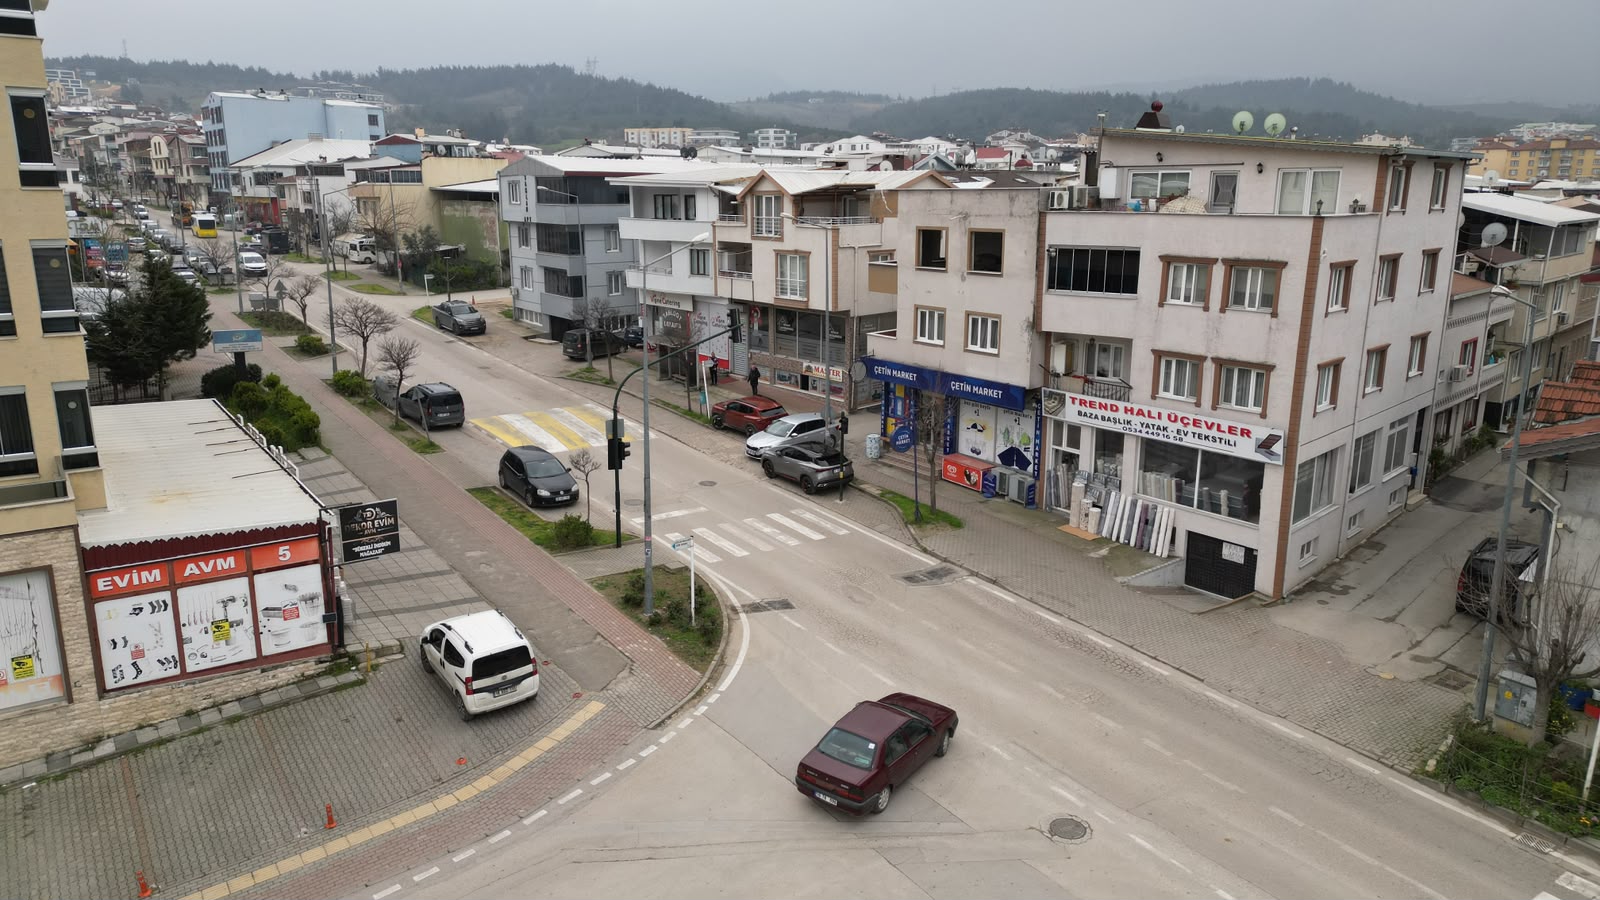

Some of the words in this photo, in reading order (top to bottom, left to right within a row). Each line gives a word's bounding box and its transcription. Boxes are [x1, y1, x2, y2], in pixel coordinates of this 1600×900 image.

[814, 366, 841, 377] MATER
[874, 365, 891, 376] ÇETİN
[892, 369, 917, 381] MARKET
[950, 381, 971, 393] ÇETİN
[972, 385, 1003, 399] MARKET
[1014, 417, 1020, 425] +1
[1069, 396, 1119, 413] TREND
[1124, 406, 1162, 420] HALI
[1167, 412, 1252, 439] ÜÇEVLER
[1078, 410, 1099, 421] BAZA
[1101, 415, 1133, 426] BAŞLIK
[1140, 421, 1169, 433] YATAK
[1176, 429, 1189, 437] EV
[1122, 426, 1143, 434] 0534
[374, 516, 394, 528] EVİM
[278, 545, 291, 561] 5
[183, 556, 236, 577] AVM
[97, 568, 161, 592] EVİM
